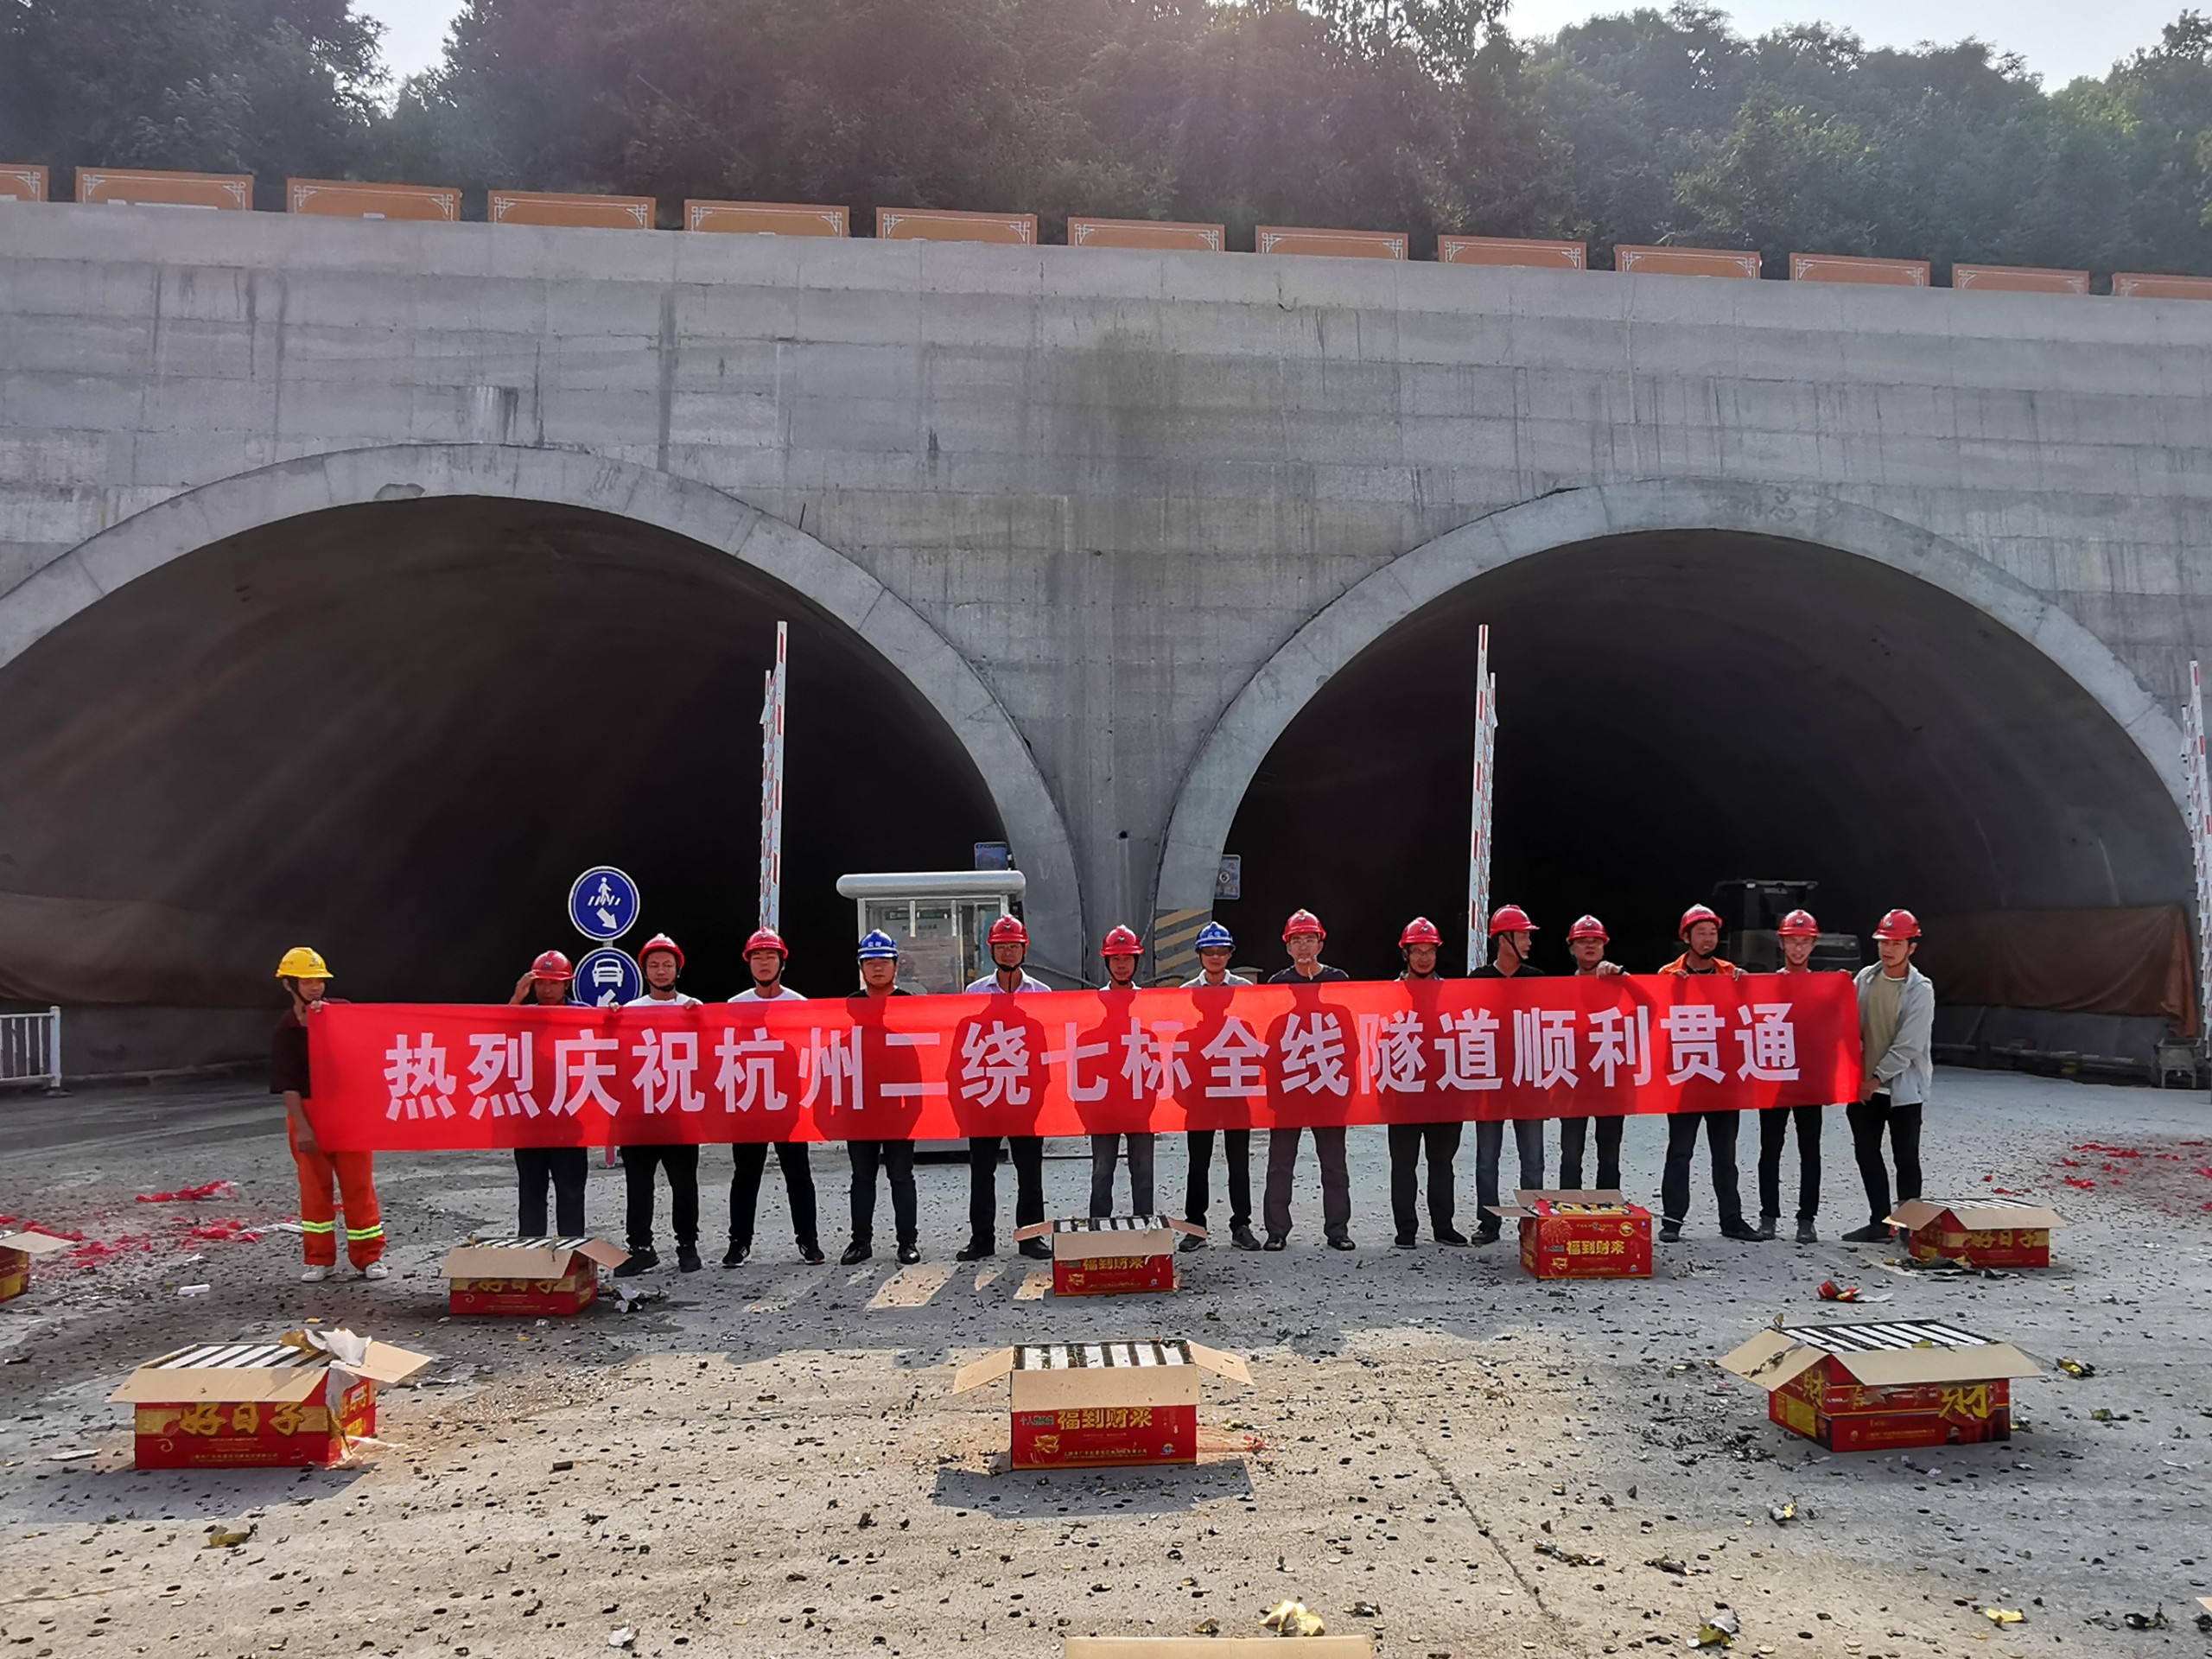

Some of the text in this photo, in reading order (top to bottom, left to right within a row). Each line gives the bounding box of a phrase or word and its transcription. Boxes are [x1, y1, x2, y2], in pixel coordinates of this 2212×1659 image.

[384, 1003, 1800, 1121] 热烈庆祝杭州二绕七标全线隧道顺利贯通
